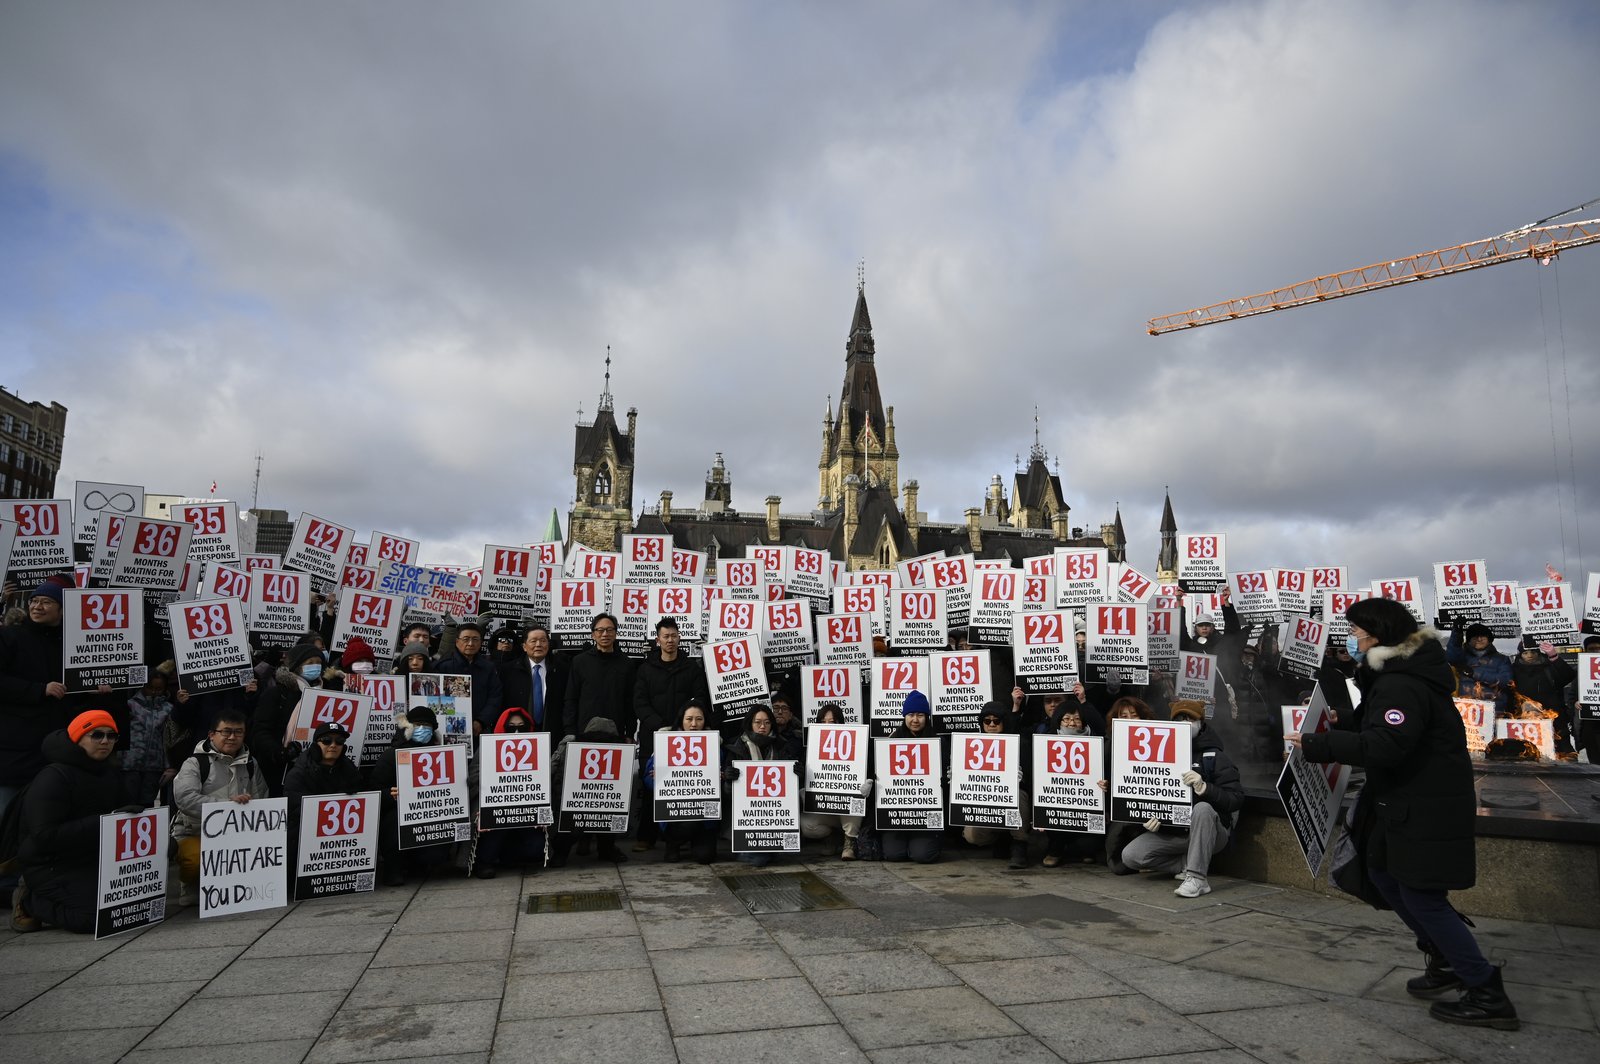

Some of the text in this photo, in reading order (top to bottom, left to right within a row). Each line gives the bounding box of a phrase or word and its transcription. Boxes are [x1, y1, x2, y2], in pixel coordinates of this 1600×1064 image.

[19, 505, 54, 535] 30
[189, 507, 221, 534] 35
[139, 524, 176, 555] 36
[310, 523, 339, 552] 42
[1191, 538, 1214, 557] 38
[382, 539, 406, 562] 39
[637, 538, 660, 560] 53
[123, 568, 157, 576] WAITING
[134, 559, 168, 567] MONTHS
[499, 551, 522, 576] 11
[588, 556, 612, 578] 15
[672, 553, 694, 575] 31
[798, 551, 819, 573] 33
[1070, 554, 1096, 579] 35
[134, 578, 177, 586] RESPONSE
[346, 568, 371, 588] 32
[389, 563, 423, 580] STOP
[429, 571, 456, 587] THE
[730, 564, 753, 585] 68
[937, 561, 964, 586] 33
[1122, 572, 1147, 594] 27
[1240, 574, 1265, 592] 32
[1281, 572, 1301, 591] 19
[1316, 570, 1338, 586] 28
[1448, 565, 1475, 585] 31
[218, 571, 246, 599] 20
[266, 576, 296, 603] 40
[566, 583, 589, 606] 71
[987, 574, 1011, 599] 70
[1384, 582, 1408, 600] 37
[662, 589, 688, 612] 63
[848, 589, 872, 611] 55
[905, 594, 932, 618] 90
[1531, 588, 1559, 609] 34
[86, 595, 125, 628] 34
[190, 605, 227, 637] 38
[355, 595, 387, 626] 54
[724, 604, 750, 628] 68
[773, 604, 798, 629] 55
[1104, 608, 1130, 634] 11
[86, 634, 123, 642] MONTHS
[832, 617, 858, 643] 34
[1029, 616, 1060, 644] 22
[1299, 620, 1319, 643] 30
[71, 654, 138, 664] IRCC RESPONSE
[76, 643, 133, 654] WAITING FOR
[718, 642, 746, 671] 39
[1030, 647, 1059, 655] MONTHS
[92, 669, 130, 677] TIMELINES
[886, 663, 913, 689] 72
[946, 657, 975, 684] 65
[1035, 664, 1072, 672] RESPONSE
[1189, 657, 1206, 679] 31
[95, 677, 127, 685] RESULTS
[817, 669, 846, 696] 40
[317, 698, 353, 730] 42
[501, 740, 533, 771] 62
[672, 737, 703, 765] 35
[823, 731, 852, 760] 40
[969, 740, 1002, 770] 34
[1134, 728, 1171, 762] 37
[418, 752, 450, 785] 31
[584, 750, 614, 779] 81
[895, 745, 925, 774] 51
[1052, 742, 1085, 773] 36
[499, 775, 532, 783] MONTHS
[750, 767, 781, 796] 43
[968, 774, 1000, 782] MONTHS
[1123, 776, 1180, 787] WAITING FOR
[1133, 766, 1170, 775] MONTHS
[417, 789, 450, 799] MONTHS
[491, 784, 541, 794] WAITING FOR
[504, 794, 545, 802] RESPONSE
[960, 784, 1008, 793] WAITING FOR
[973, 794, 1013, 803] RESPONSE
[1118, 787, 1185, 798] IRCC RESPONSE
[405, 807, 464, 821] IRCC RESPONSE
[409, 798, 459, 811] WAITING FOR
[504, 808, 538, 816] TIMELINES
[972, 808, 1006, 816] TIMELINES
[203, 809, 287, 838] CANADA
[322, 800, 360, 835] 36
[413, 822, 458, 835] NO TIMELINES
[975, 816, 1002, 824] RESULTS
[121, 817, 152, 860] 18
[416, 831, 455, 843] NO RESULTS
[118, 861, 150, 875] MONTHS
[202, 847, 283, 876] WHAT ARE
[110, 871, 158, 890] WAITING FOR
[104, 882, 162, 903] IRCC RESPONSE
